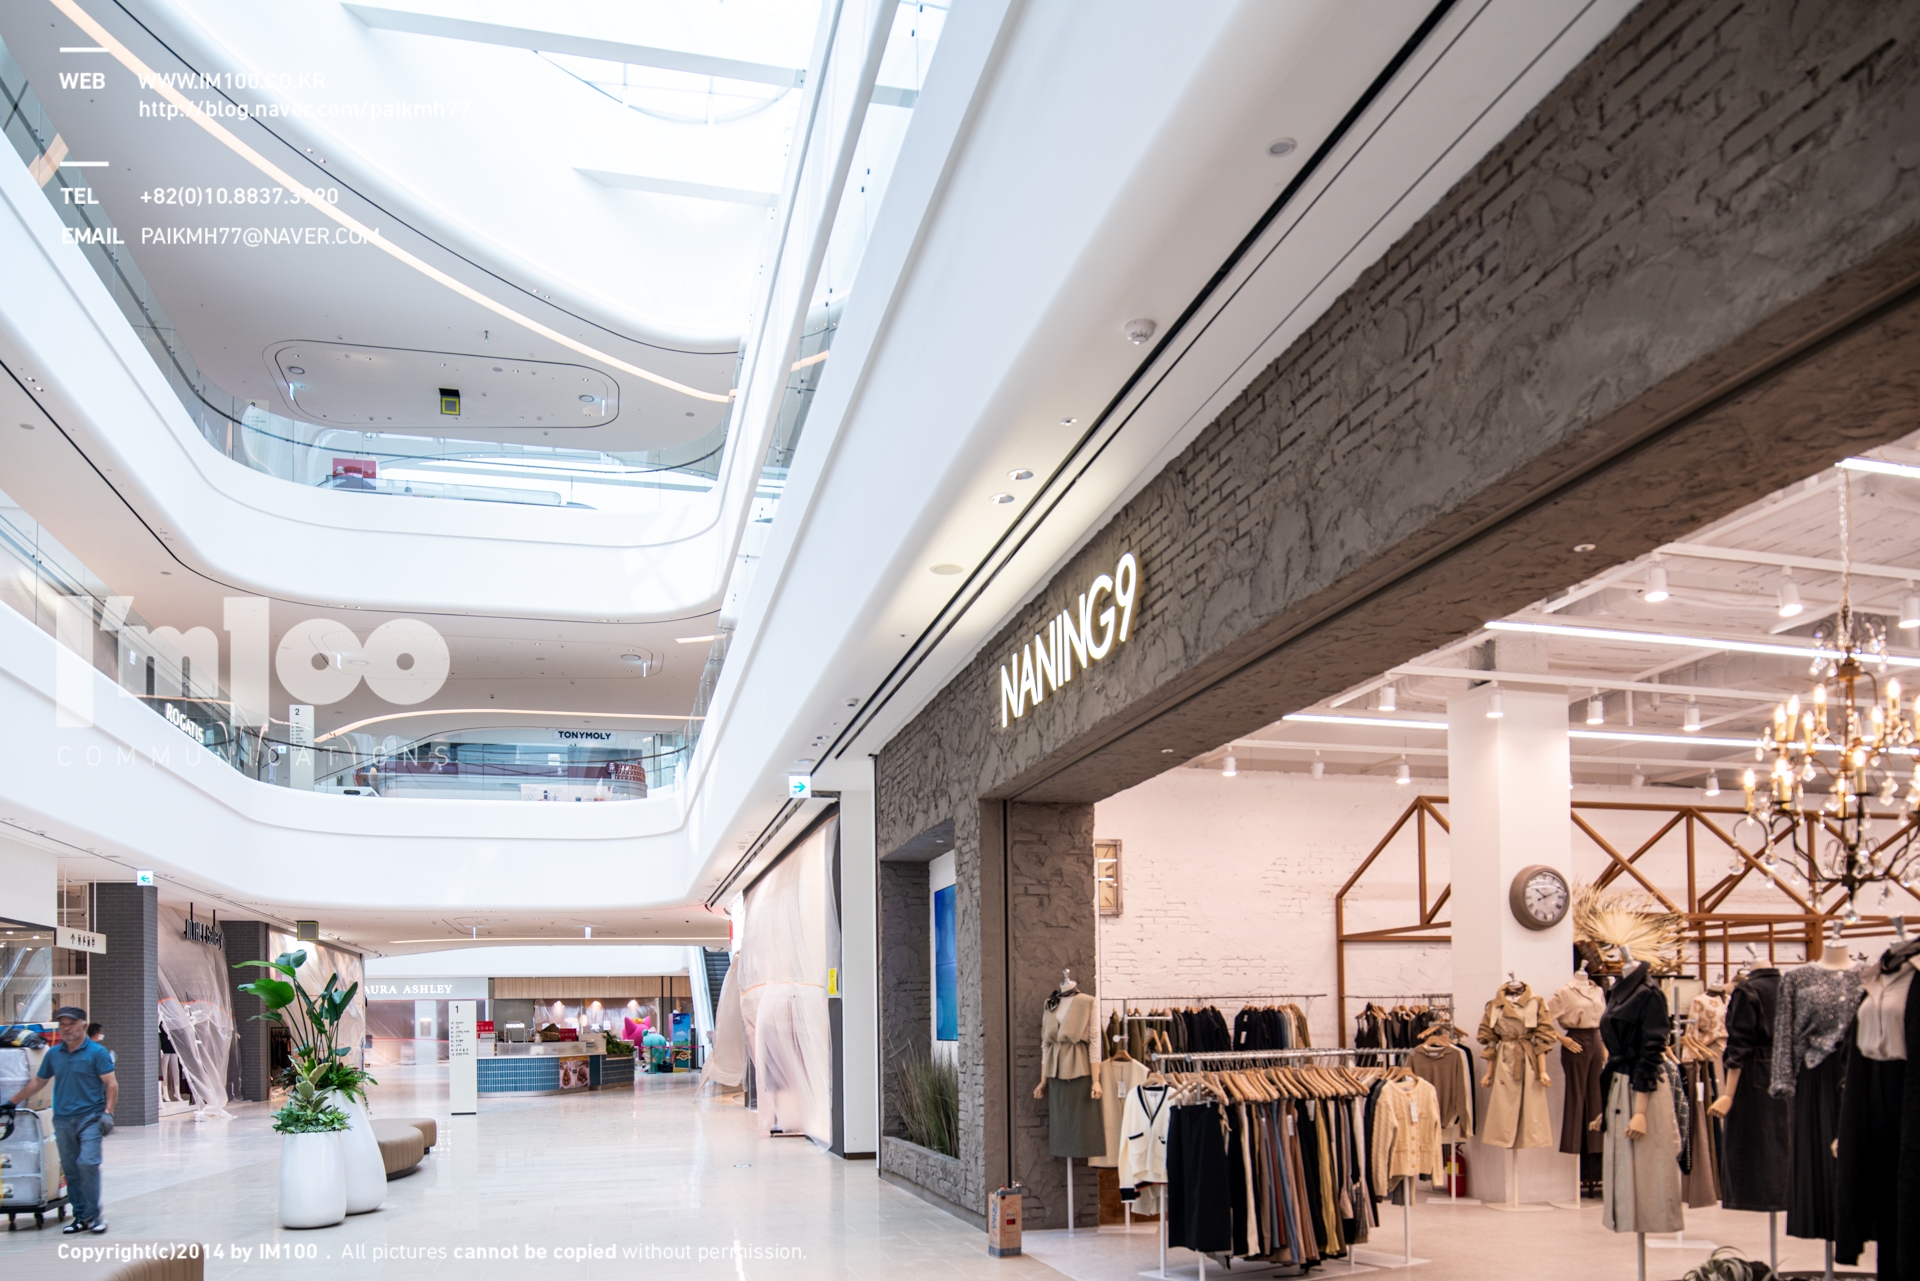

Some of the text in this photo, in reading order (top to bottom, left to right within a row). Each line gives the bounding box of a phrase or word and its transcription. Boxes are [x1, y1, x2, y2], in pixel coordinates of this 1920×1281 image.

[1001, 552, 1138, 729] NANING9
[294, 707, 300, 716] 2
[165, 702, 204, 743] ROGATIS
[558, 730, 611, 740] TONYMOLY
[403, 984, 453, 994] ASHLEY
[455, 1005, 459, 1014] 1
